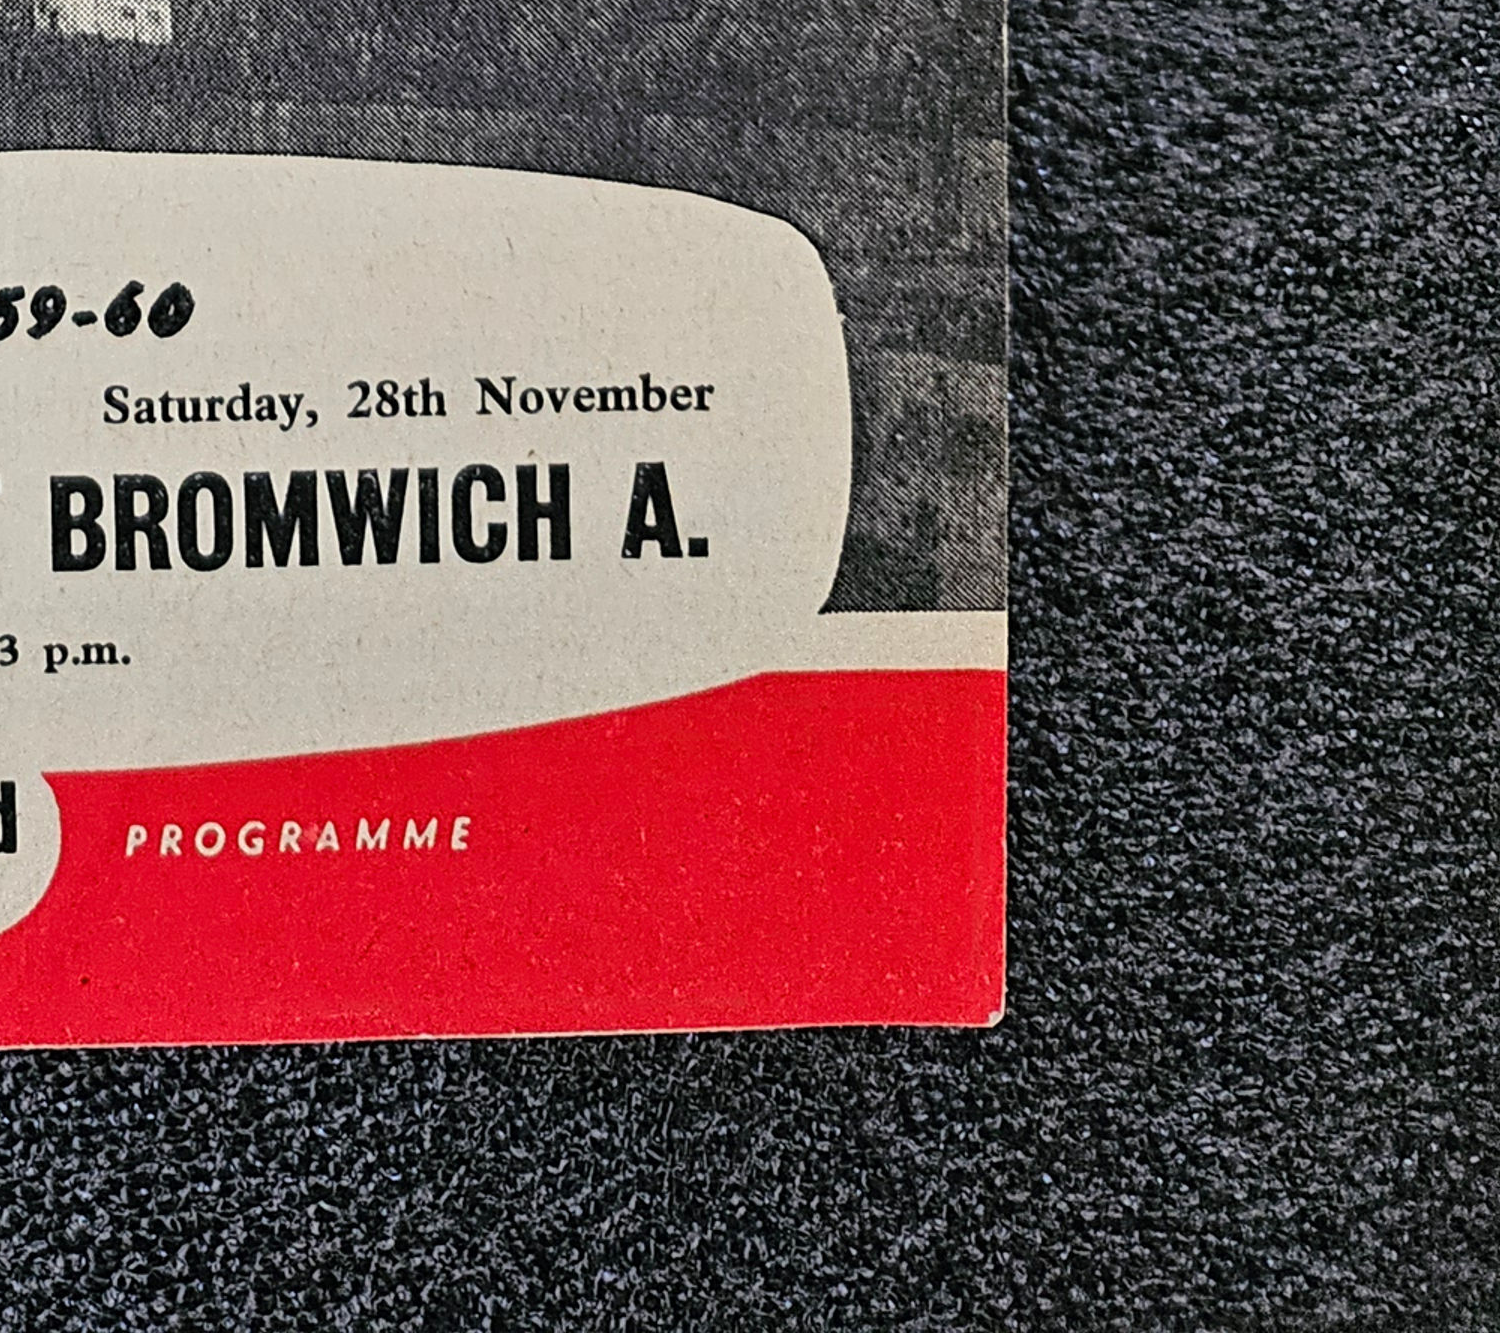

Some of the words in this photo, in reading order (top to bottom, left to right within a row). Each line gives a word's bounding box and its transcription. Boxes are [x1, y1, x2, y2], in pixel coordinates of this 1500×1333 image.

[102, 381, 319, 433] Saturday,
[346, 376, 448, 420] 28th
[473, 371, 716, 416] November
[48, 462, 573, 574] BROMWICH
[620, 460, 710, 561] A.
[42, 641, 132, 675] p.m.
[124, 815, 472, 858] PROGRAMME
